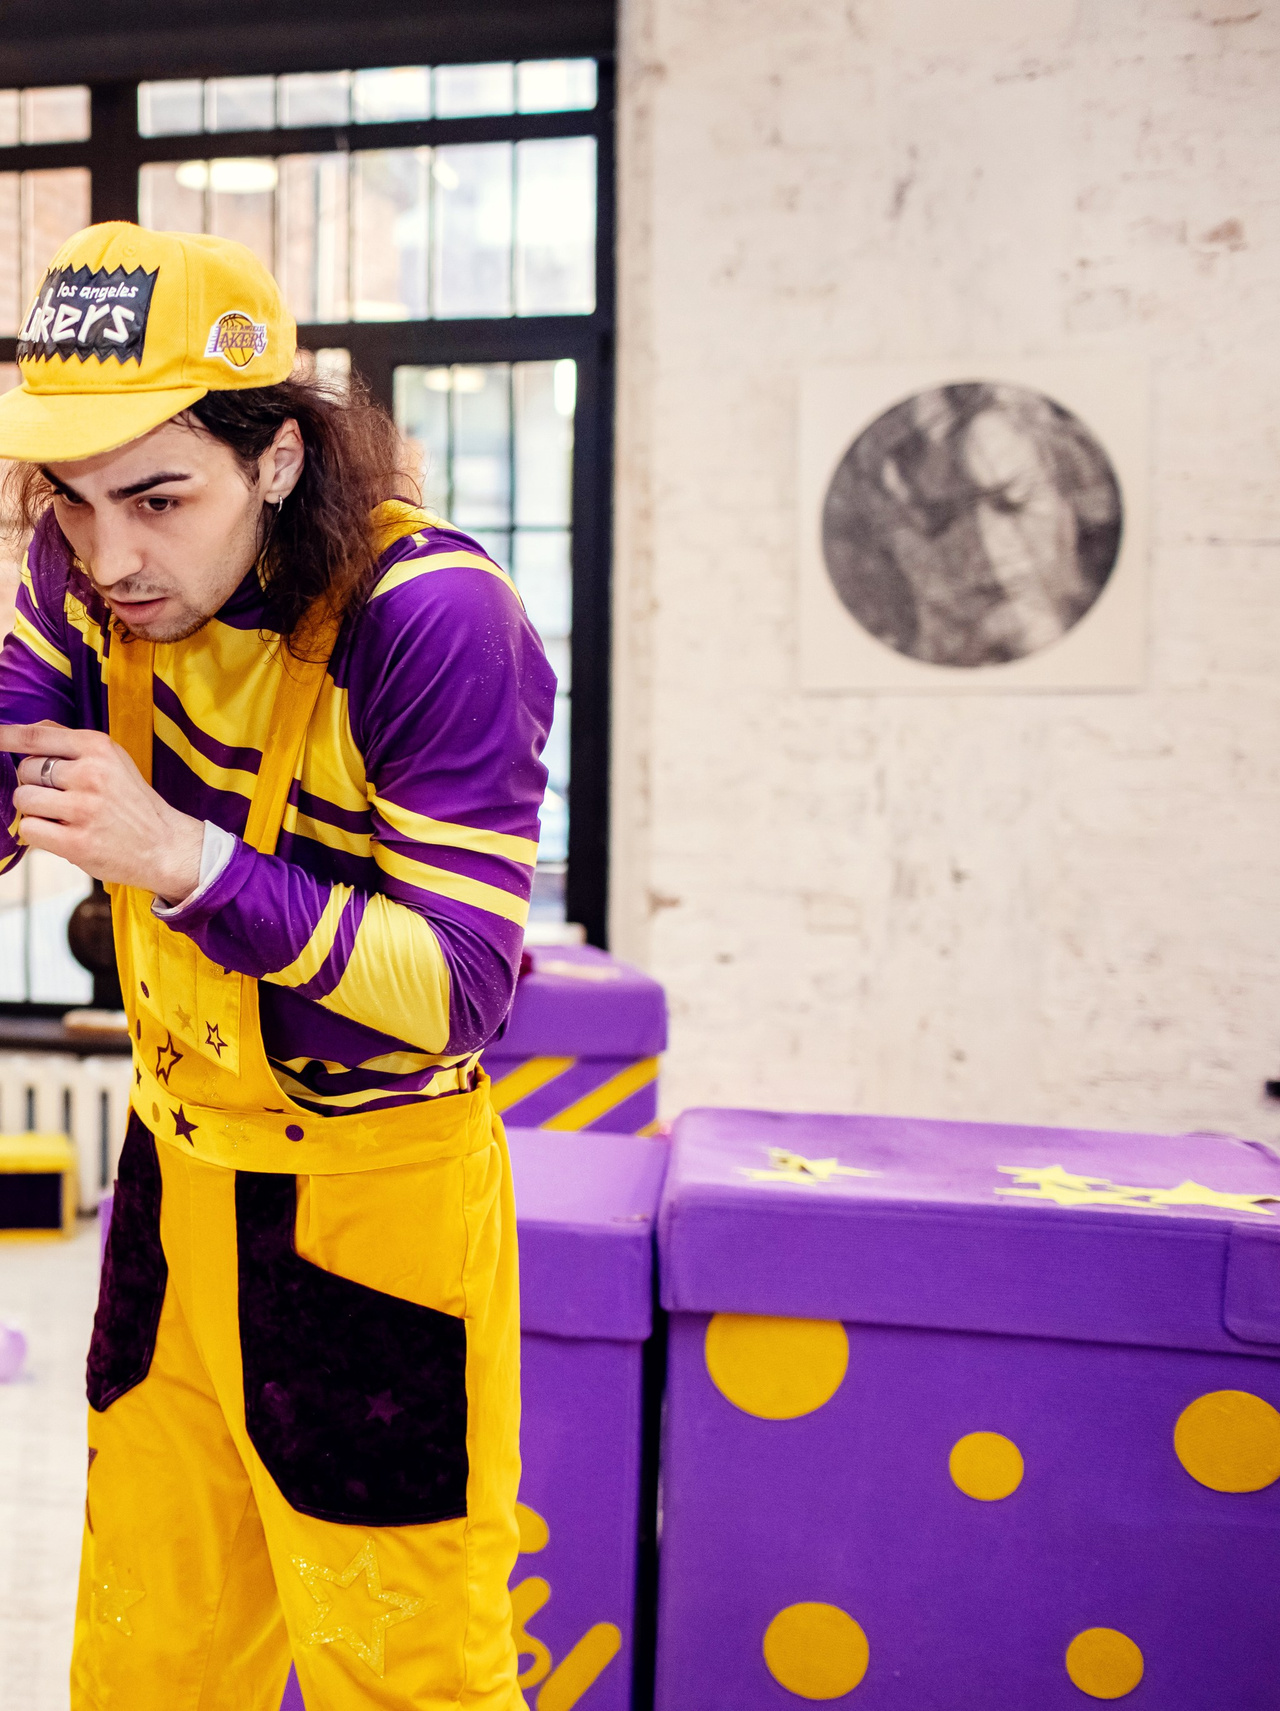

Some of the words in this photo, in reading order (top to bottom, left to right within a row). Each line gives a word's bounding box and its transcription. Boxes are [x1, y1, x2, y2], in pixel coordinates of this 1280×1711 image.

[56, 281, 78, 298] los
[79, 281, 139, 303] angeles
[208, 325, 267, 354] LAKERS
